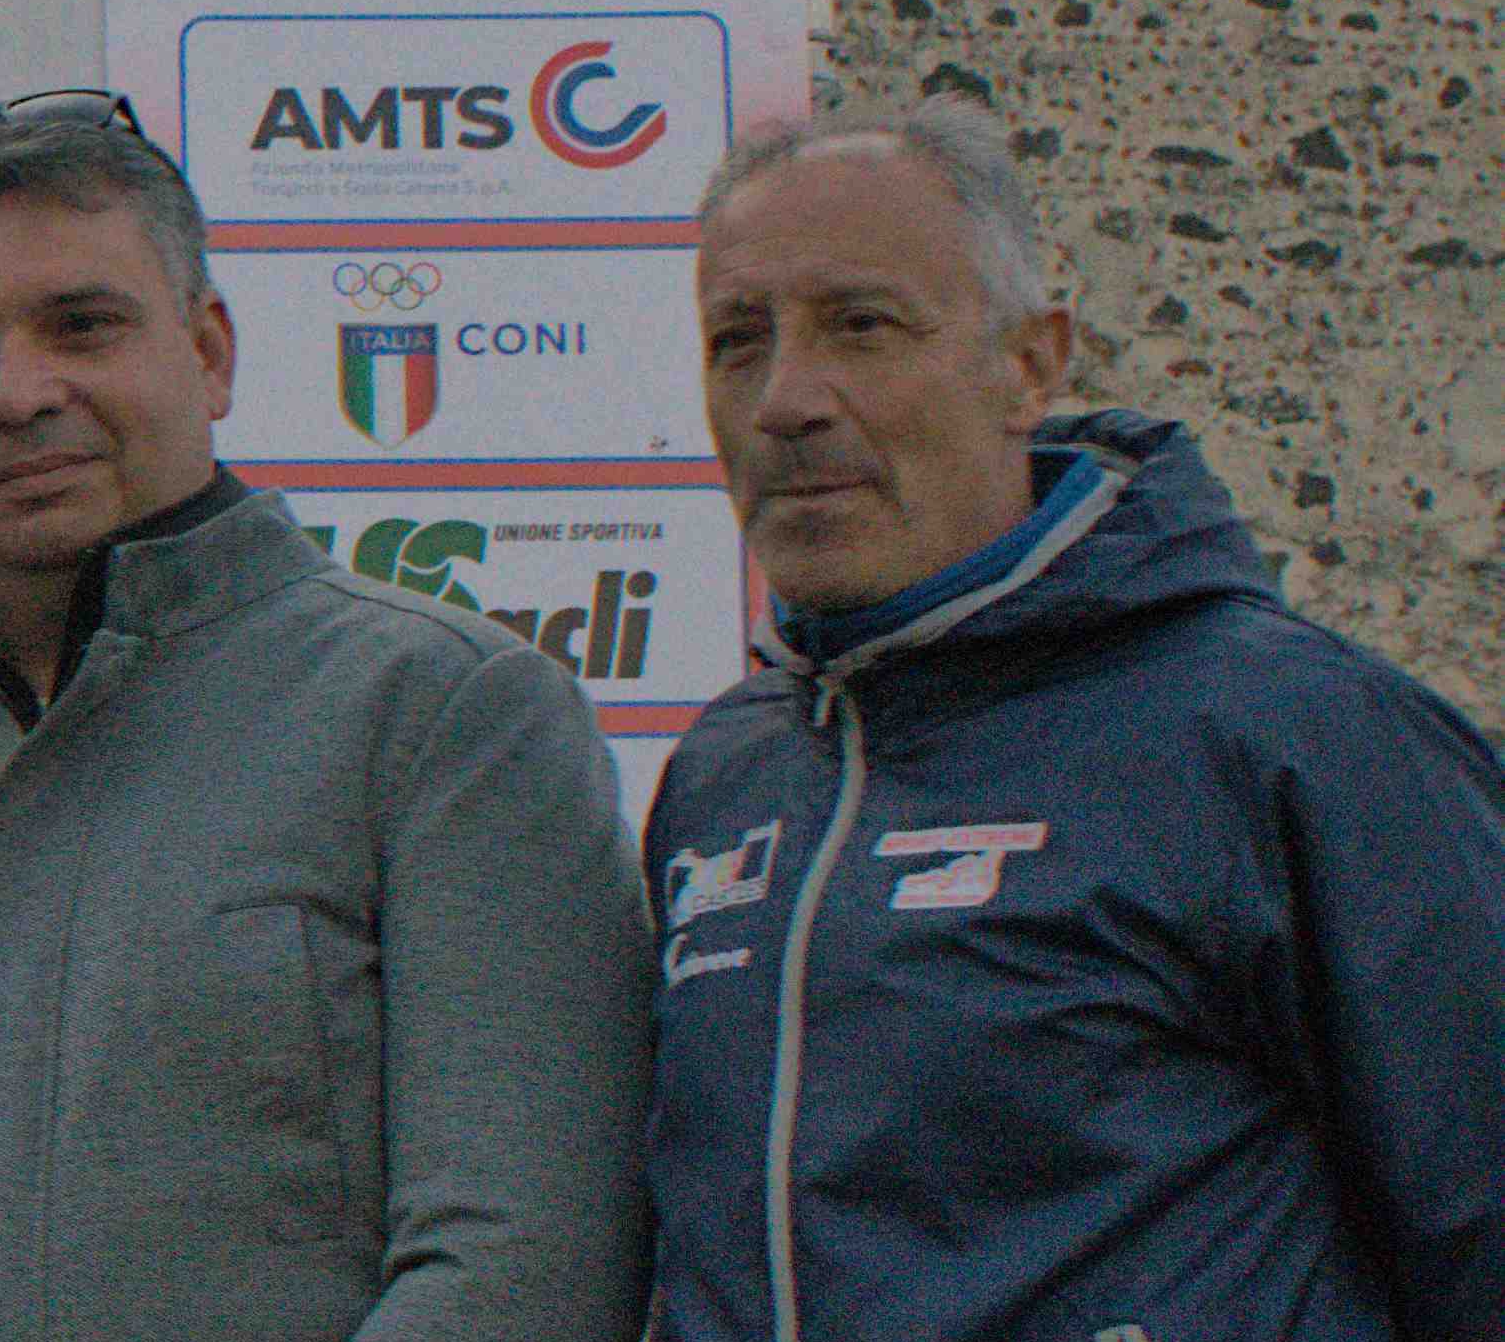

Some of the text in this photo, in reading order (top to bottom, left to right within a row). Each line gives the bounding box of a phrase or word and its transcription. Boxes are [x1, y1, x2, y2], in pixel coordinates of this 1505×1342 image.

[249, 85, 515, 151] AMTS
[456, 321, 588, 357] CONI
[495, 522, 664, 542] UNIONE SPORTIVA
